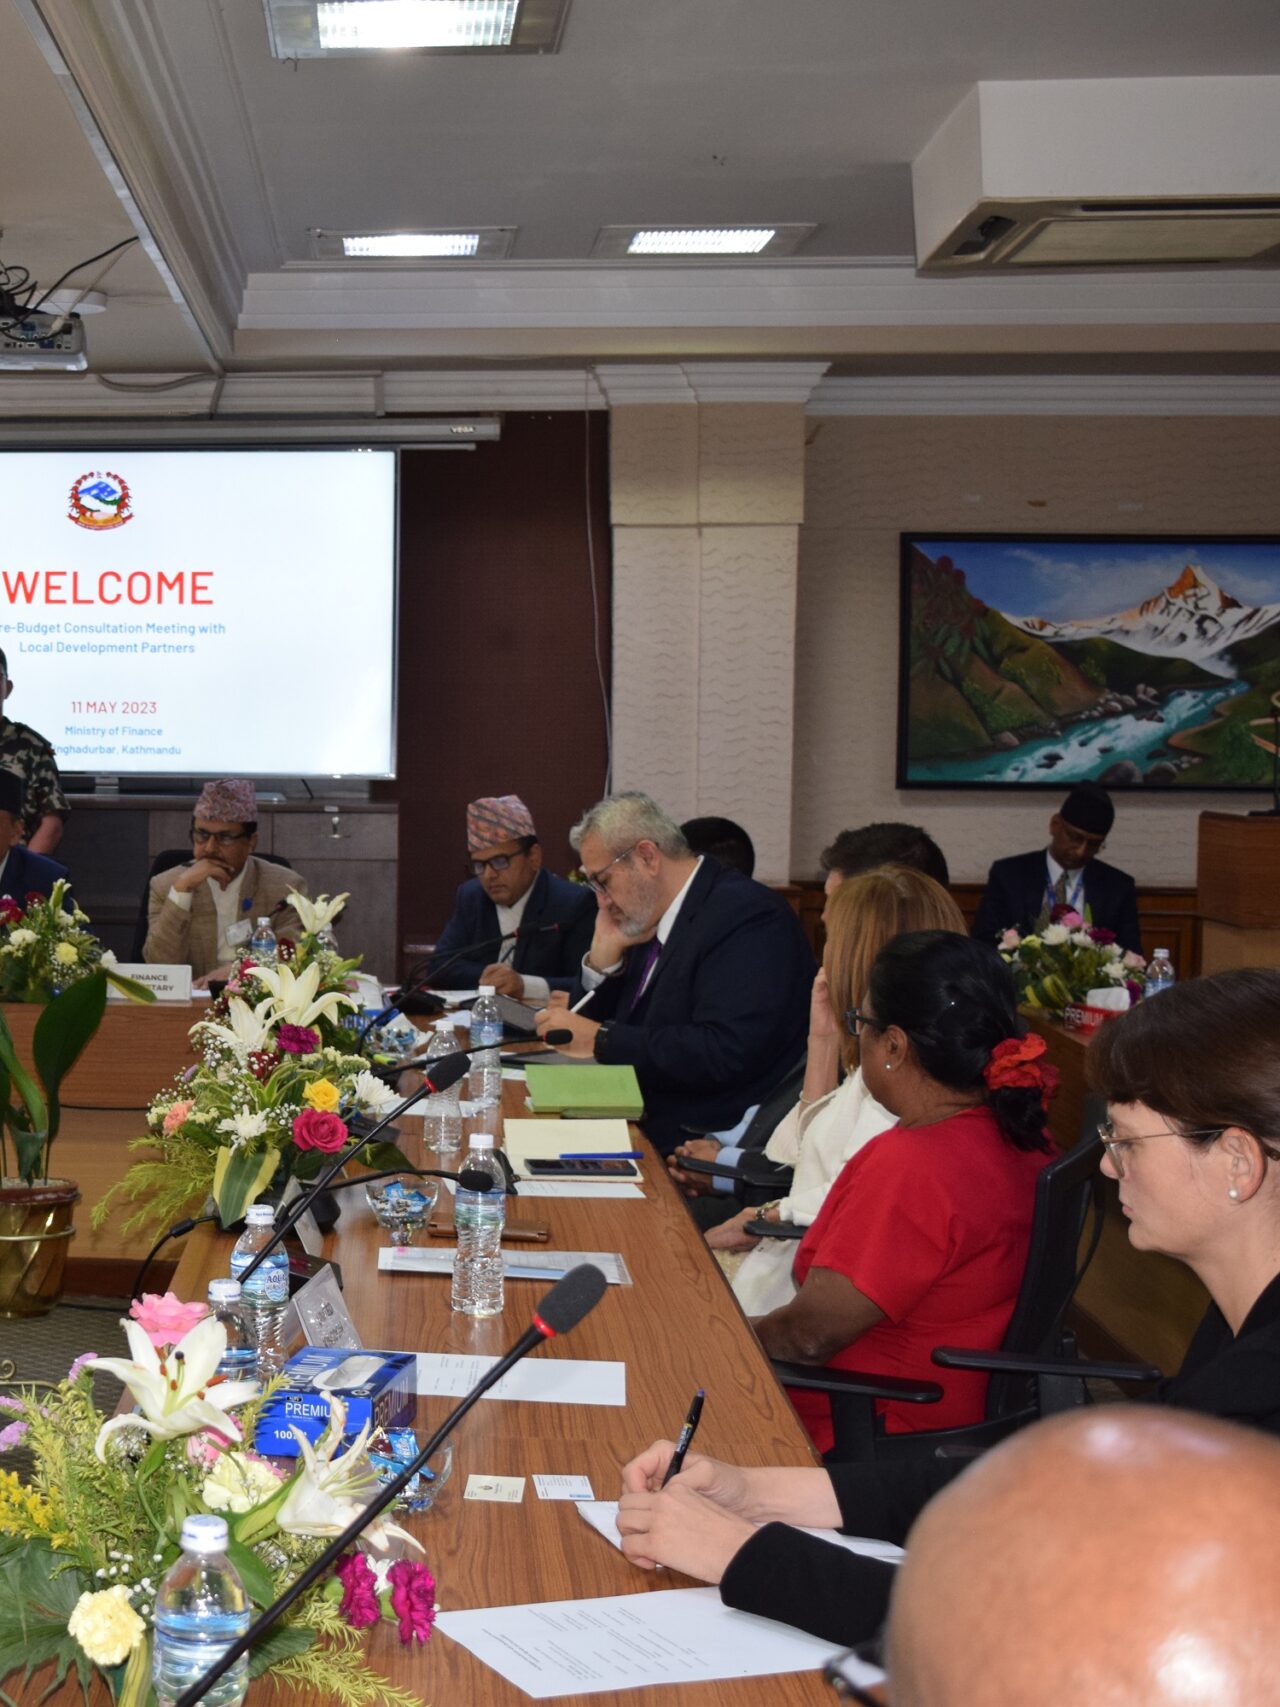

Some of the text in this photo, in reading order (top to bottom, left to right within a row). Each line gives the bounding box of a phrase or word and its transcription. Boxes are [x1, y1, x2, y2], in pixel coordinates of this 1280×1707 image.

[2, 571, 214, 605] WELCOME
[64, 622, 143, 634] Consultation
[146, 622, 196, 636] Meeting
[198, 622, 226, 634] with
[20, 641, 195, 655] Local Development Partners
[71, 701, 158, 714] 11 MAY 2023
[65, 726, 163, 737] Ministry of Finance
[122, 745, 181, 755] Kathmandu
[285, 1402, 331, 1418] PREMIU
